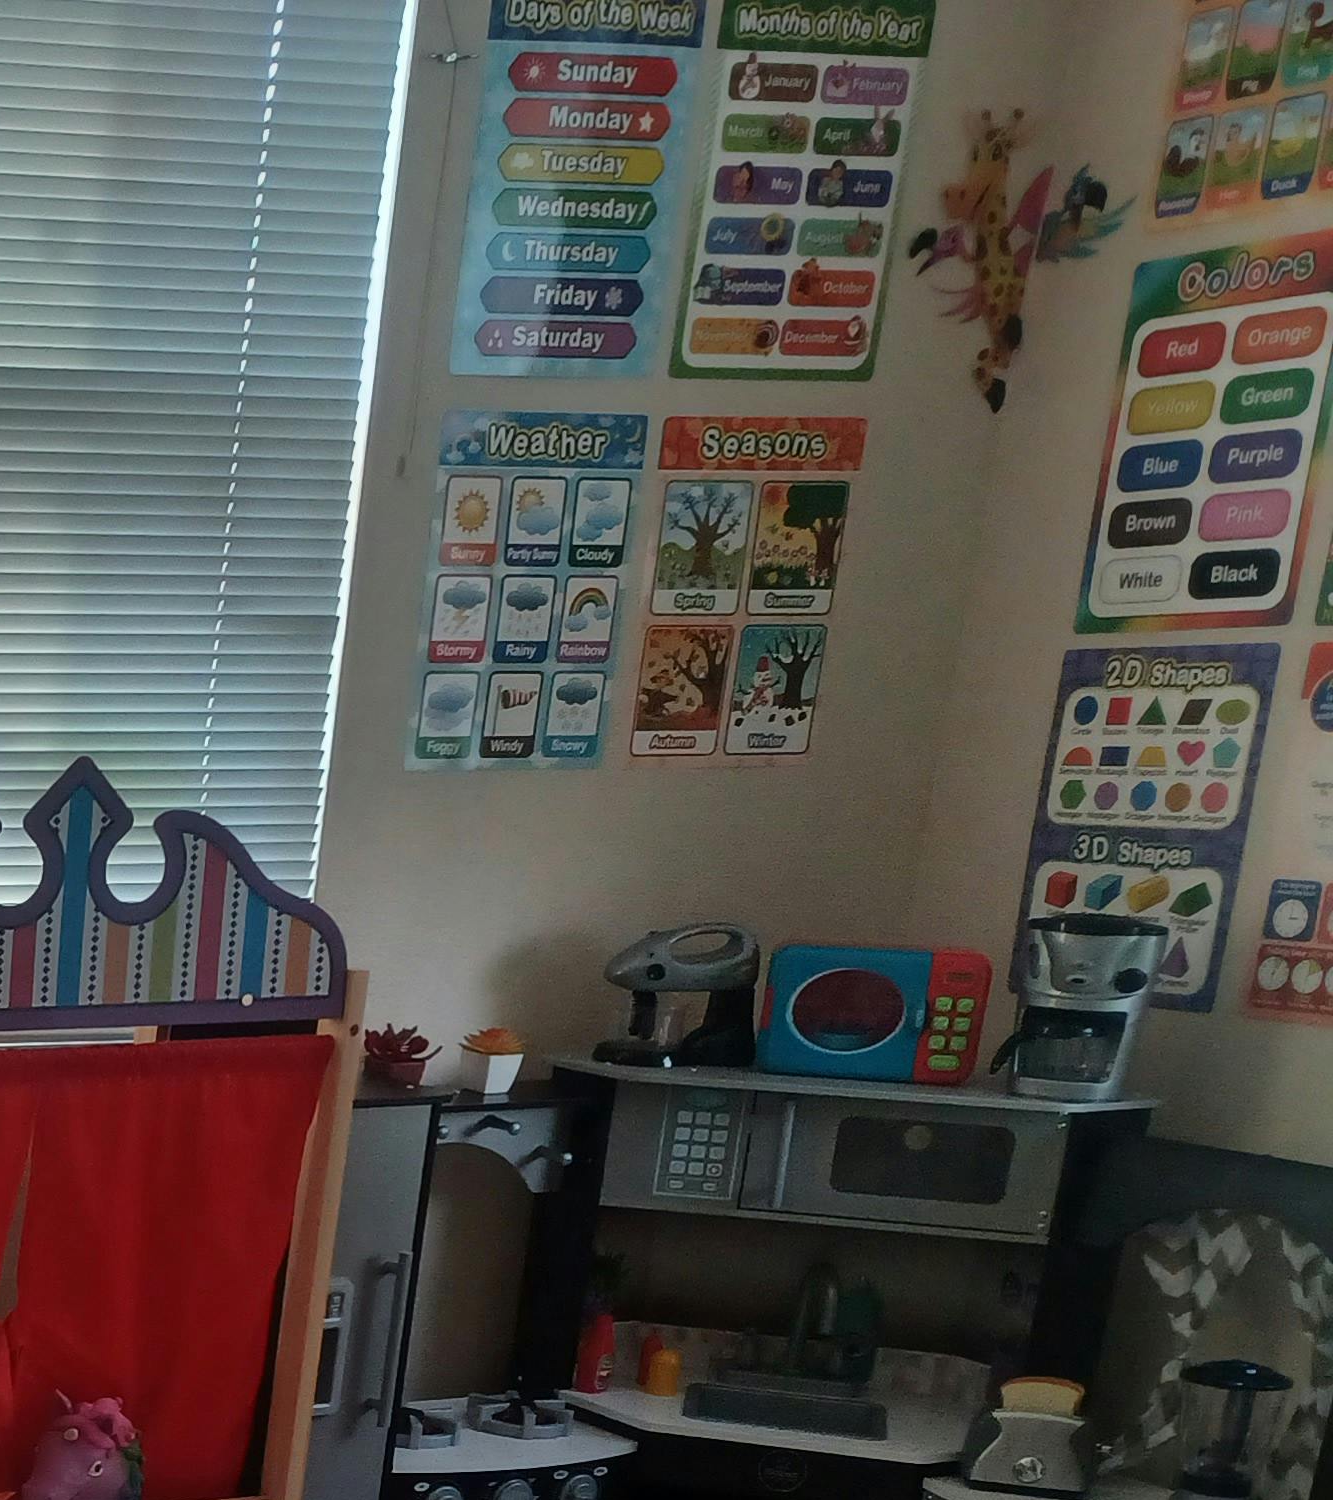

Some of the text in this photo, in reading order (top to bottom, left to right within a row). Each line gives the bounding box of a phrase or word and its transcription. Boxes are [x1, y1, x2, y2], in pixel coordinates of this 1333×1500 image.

[507, 0, 691, 32] Days of the Week
[738, 6, 923, 43] Months of the Year
[556, 59, 638, 88] Sunday
[765, 75, 811, 92] January
[852, 78, 904, 95] February
[549, 106, 634, 133] Monday
[823, 128, 851, 144] April
[541, 149, 628, 178] Tuesday
[771, 178, 794, 193] May
[853, 181, 882, 195] June
[516, 195, 638, 223] Wednesday
[712, 230, 738, 245] July
[524, 239, 619, 267] Thursday
[1177, 249, 1316, 303] Colors
[723, 279, 783, 296] September
[823, 281, 869, 295] October
[533, 284, 598, 312] Friday
[512, 326, 606, 352] Saturday
[784, 331, 840, 344] December
[1248, 325, 1313, 348] Orange
[1166, 338, 1199, 359] Red
[1241, 384, 1294, 406] Green
[1148, 400, 1200, 419] Yellow
[487, 423, 607, 460] Weather
[701, 426, 828, 460] Seasons
[1227, 444, 1285, 467] Purple
[1142, 456, 1179, 476] Blue
[1226, 503, 1264, 523] Pink
[1125, 513, 1177, 533] Brown
[451, 546, 486, 563] Sunny
[507, 547, 533, 562] Partly
[575, 547, 615, 565] Cloudy
[1119, 571, 1163, 590] White
[1210, 564, 1259, 583] Black
[674, 592, 716, 611] Spring
[436, 644, 478, 660] Stormy
[505, 644, 537, 660] Rainy
[560, 643, 607, 658] Rainbow
[1105, 658, 1229, 690] 2D Shapes
[490, 738, 524, 754] Windy
[552, 739, 589, 755] Snowy
[649, 734, 696, 750] Autumn
[748, 733, 787, 749] Winter
[1073, 834, 1192, 868] 3D Shapes
